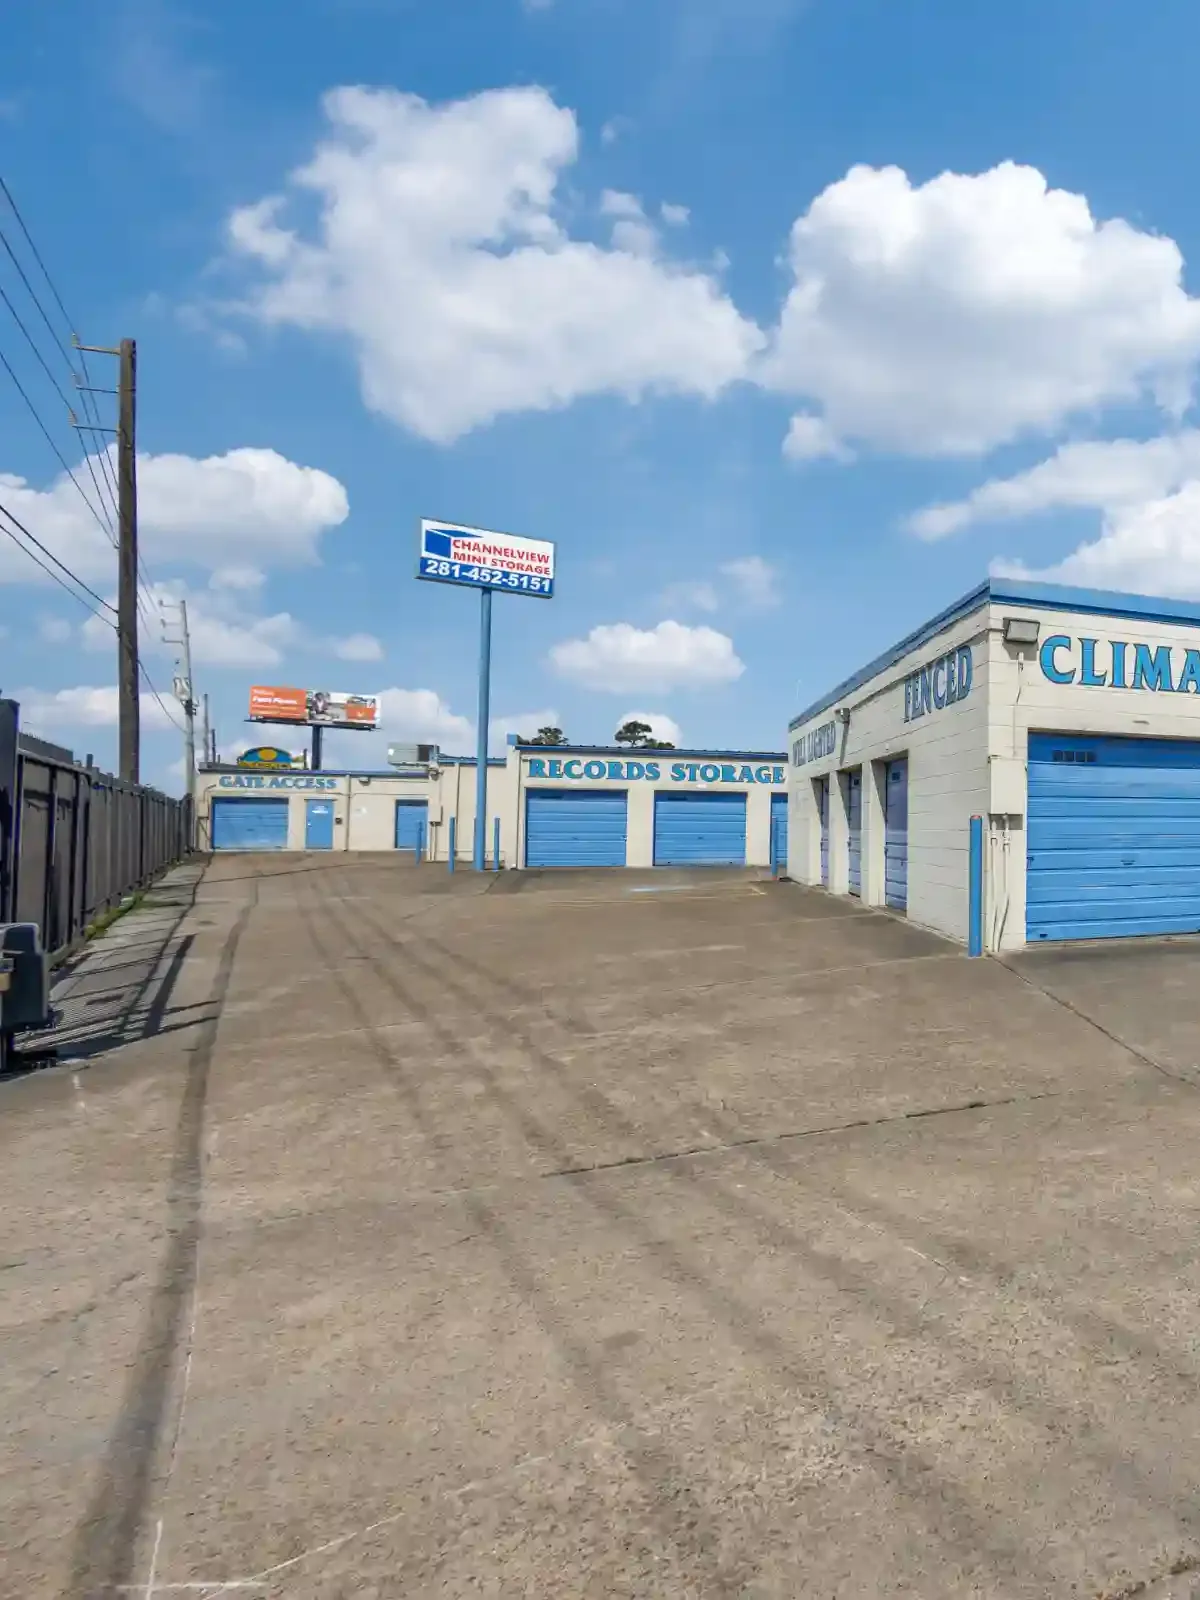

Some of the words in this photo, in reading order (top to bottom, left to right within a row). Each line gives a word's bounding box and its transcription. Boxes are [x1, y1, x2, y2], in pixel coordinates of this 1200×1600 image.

[452, 539, 550, 564] CHANNELVIEW
[453, 551, 486, 565] MINI
[491, 558, 551, 575] STORAGE
[425, 559, 550, 592] 281-452-5151
[903, 644, 973, 723] FENCED
[219, 775, 265, 789] GATE
[269, 776, 338, 790] ACCESS
[528, 758, 661, 781] RECORDS
[670, 762, 786, 784] STORAGE
